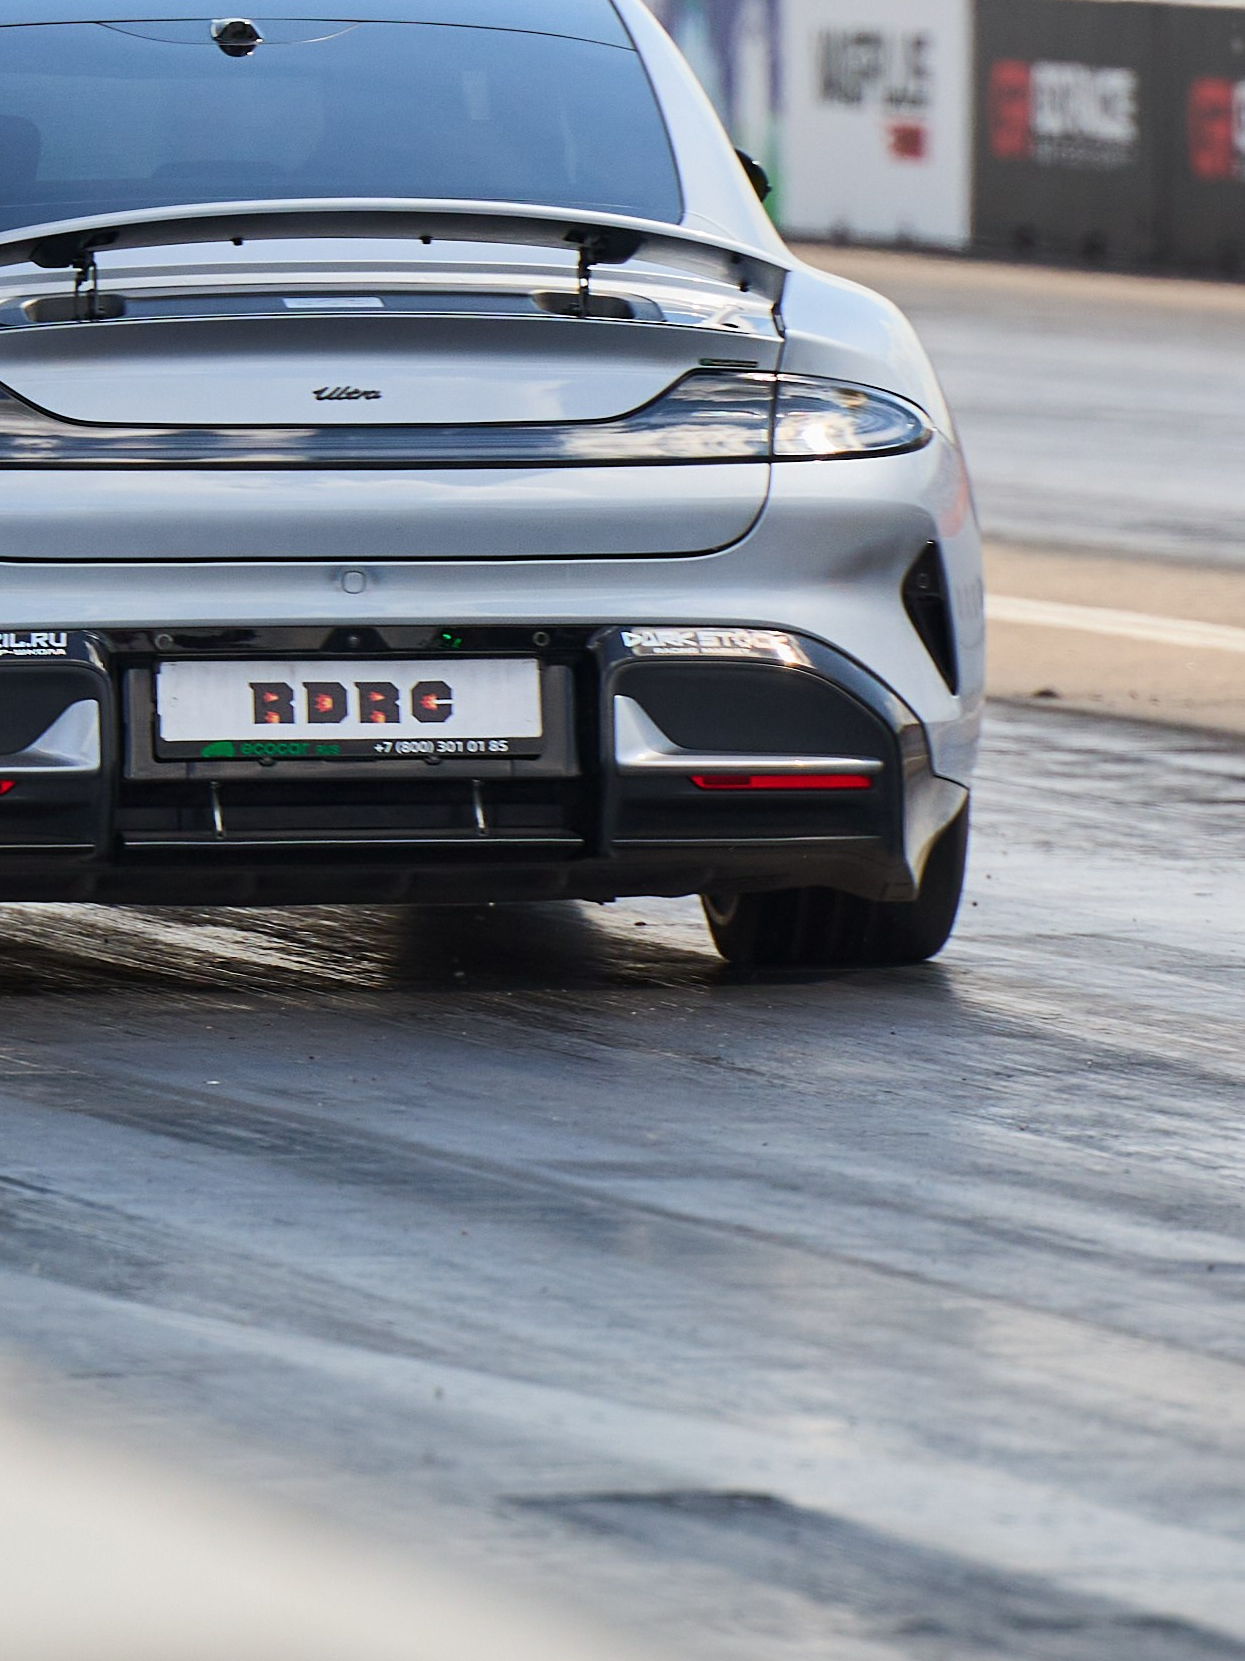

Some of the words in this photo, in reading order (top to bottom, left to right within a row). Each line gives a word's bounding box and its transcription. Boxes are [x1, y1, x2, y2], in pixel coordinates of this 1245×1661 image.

[312, 386, 382, 400] Ultra
[621, 631, 698, 648] DARK
[249, 681, 454, 724] RDRC
[240, 742, 310, 755] ecocar
[373, 741, 393, 753] +7
[394, 740, 435, 754] (800)
[436, 740, 464, 753] 301
[466, 740, 486, 752] 01
[488, 740, 509, 752] 85
